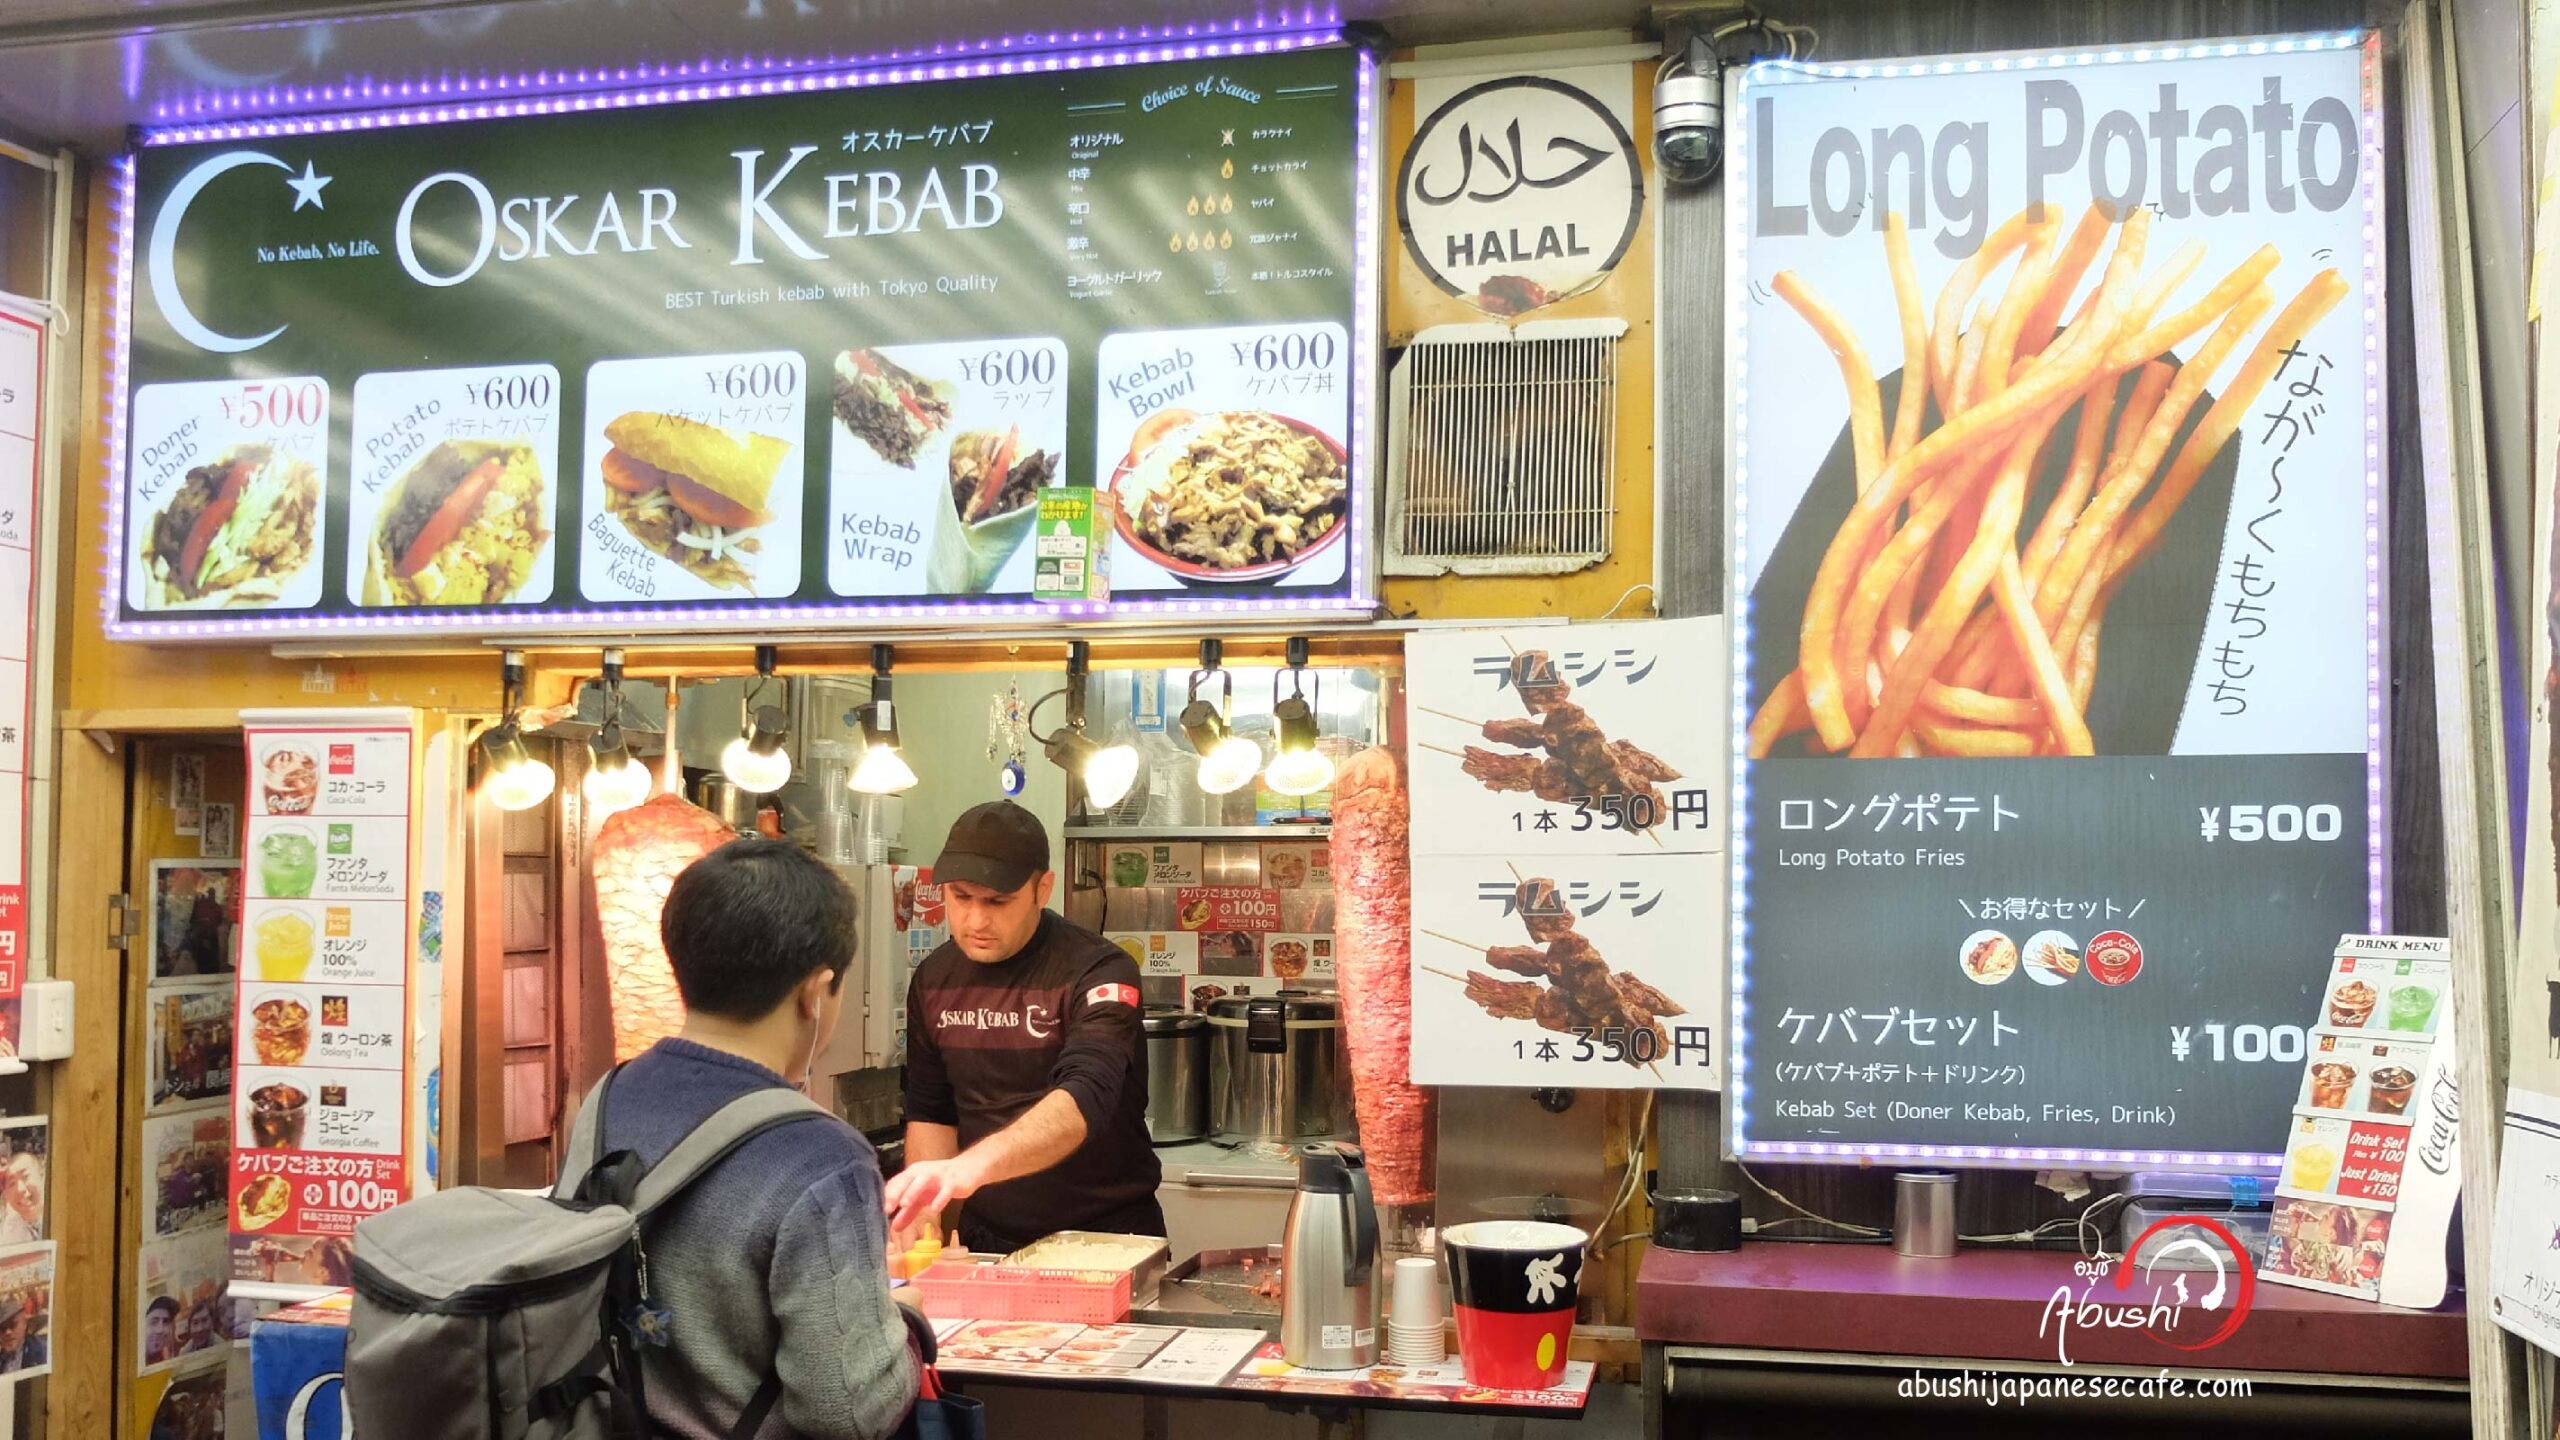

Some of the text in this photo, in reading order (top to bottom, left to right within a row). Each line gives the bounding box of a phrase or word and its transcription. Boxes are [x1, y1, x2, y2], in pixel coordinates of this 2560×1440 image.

[1142, 75, 1261, 112] Choice of Sauce
[841, 120, 993, 154] オスカーケバブ
[1070, 132, 1124, 148] オリジナル
[1415, 116, 1615, 206] حلال
[1755, 76, 2360, 261] Long Potato
[395, 145, 1004, 287] OSKAR KEBAB
[257, 247, 275, 263] No
[326, 241, 347, 258] No
[1447, 223, 1590, 268] HALAL
[665, 274, 999, 310] BEST Turkish kebab with Tokyo Quality
[958, 347, 1056, 387] ¥600
[1230, 331, 1334, 373] ¥600
[705, 361, 796, 400] ¥600
[1107, 348, 1194, 399] Kebab
[1128, 371, 1196, 419] Bowl
[140, 415, 201, 468] Doner
[365, 398, 442, 458] Potato
[137, 441, 199, 502] Kebab
[362, 431, 425, 494] Kebab
[587, 513, 656, 573] Baguette
[841, 513, 921, 545] Kebab
[843, 538, 913, 572] Wrap
[606, 558, 656, 598] Kebab
[1473, 649, 1658, 692] ラムシシ
[1780, 792, 2019, 832] ロングポテト
[2199, 804, 2342, 842] ¥500
[326, 857, 368, 870] ファンタ
[326, 870, 388, 883] メロンソーダ
[1779, 848, 1965, 870] Long Potato Fries
[1181, 888, 1261, 899] ケバブご注文の方
[1478, 881, 1664, 918] ラムシシ
[324, 939, 367, 952] オレンジ
[2355, 938, 2444, 952] DRINK MENU
[977, 1008, 1019, 1030] KEBAB
[1777, 1005, 2019, 1047] ケバブセット
[338, 1033, 393, 1047] ウーロン茶
[2170, 1024, 2314, 1062] ¥100
[319, 1108, 375, 1122] ジョージア
[319, 1123, 360, 1135] コーヒー
[1776, 1099, 2177, 1126] Kebab Set (Doner Kebab, Fries, Drink)
[2349, 1131, 2406, 1150] Drink Set
[237, 1153, 374, 1178] ケバブご注文の方
[376, 1159, 400, 1170] Drink
[376, 1169, 391, 1180] Set
[2340, 1166, 2400, 1183] Just Drink
